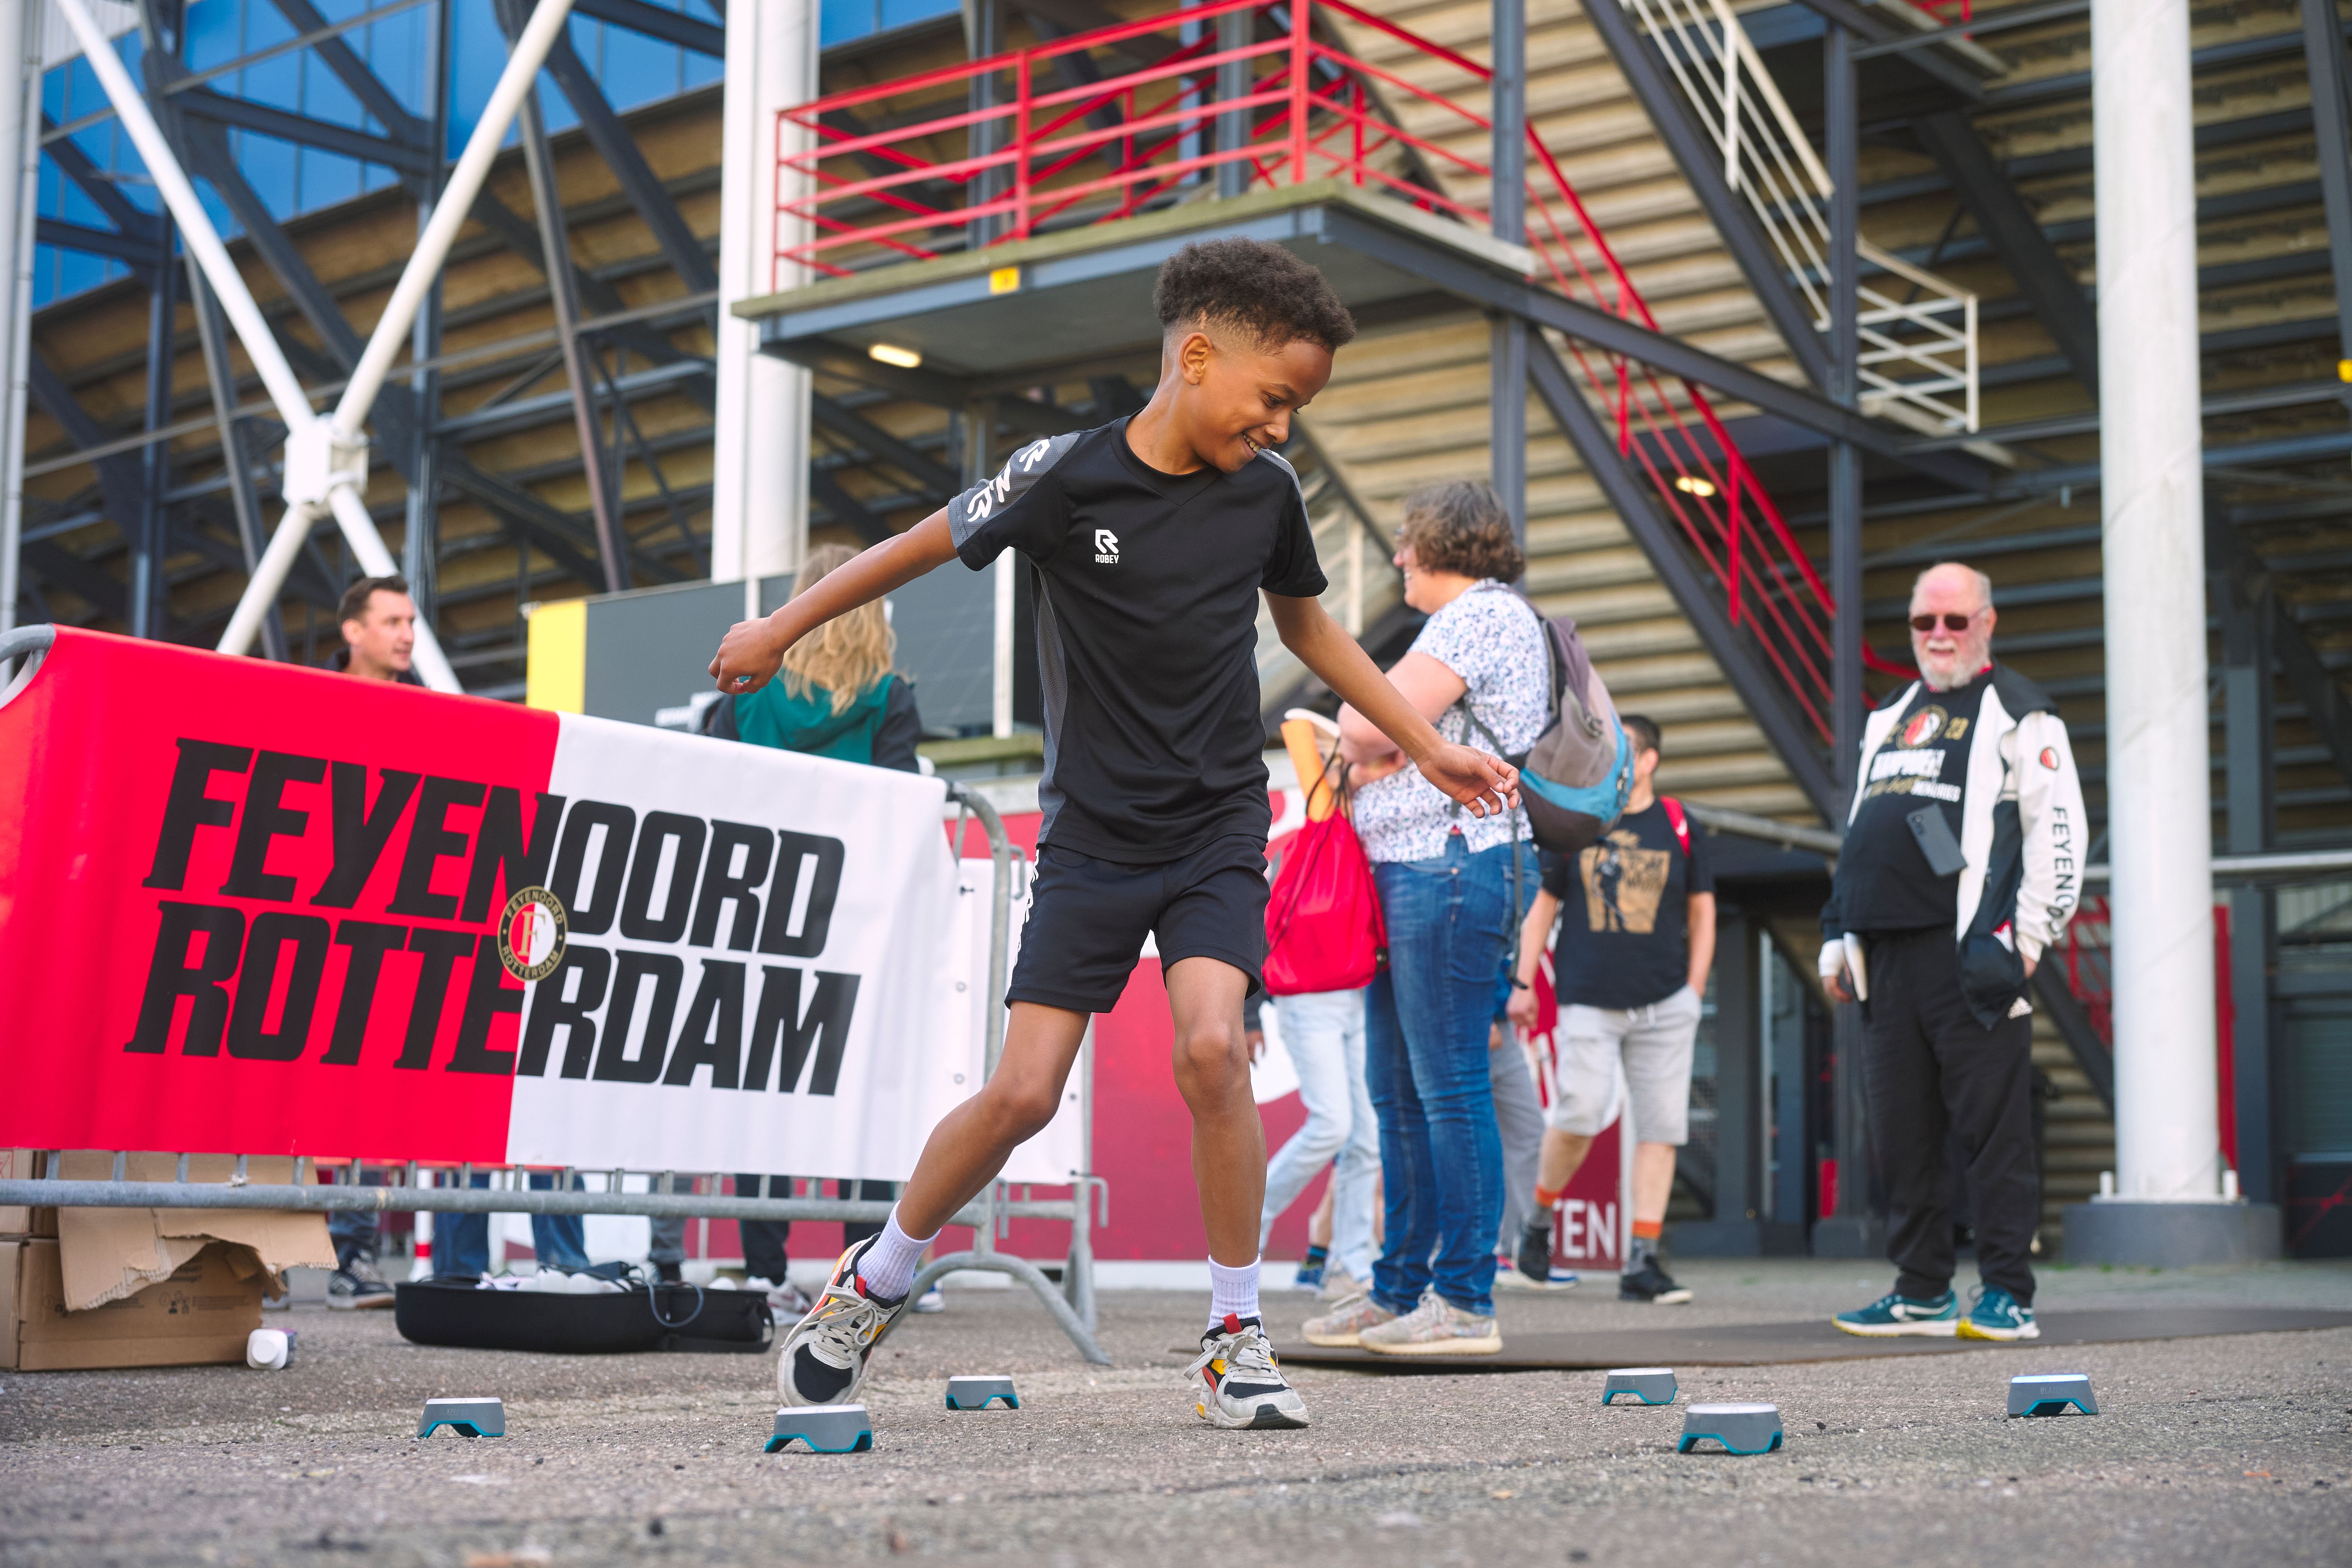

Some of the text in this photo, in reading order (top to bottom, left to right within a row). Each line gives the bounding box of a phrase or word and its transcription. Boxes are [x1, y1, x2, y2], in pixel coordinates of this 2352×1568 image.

[1095, 554, 1119, 564] ROBEY
[142, 737, 845, 958] FEYENOORD
[506, 890, 564, 925] FEYENOORD
[517, 910, 546, 957] F
[501, 945, 560, 979] ROTTERDAM
[123, 901, 861, 1096] ROTTERDAM
[1547, 1198, 1617, 1260] EN
